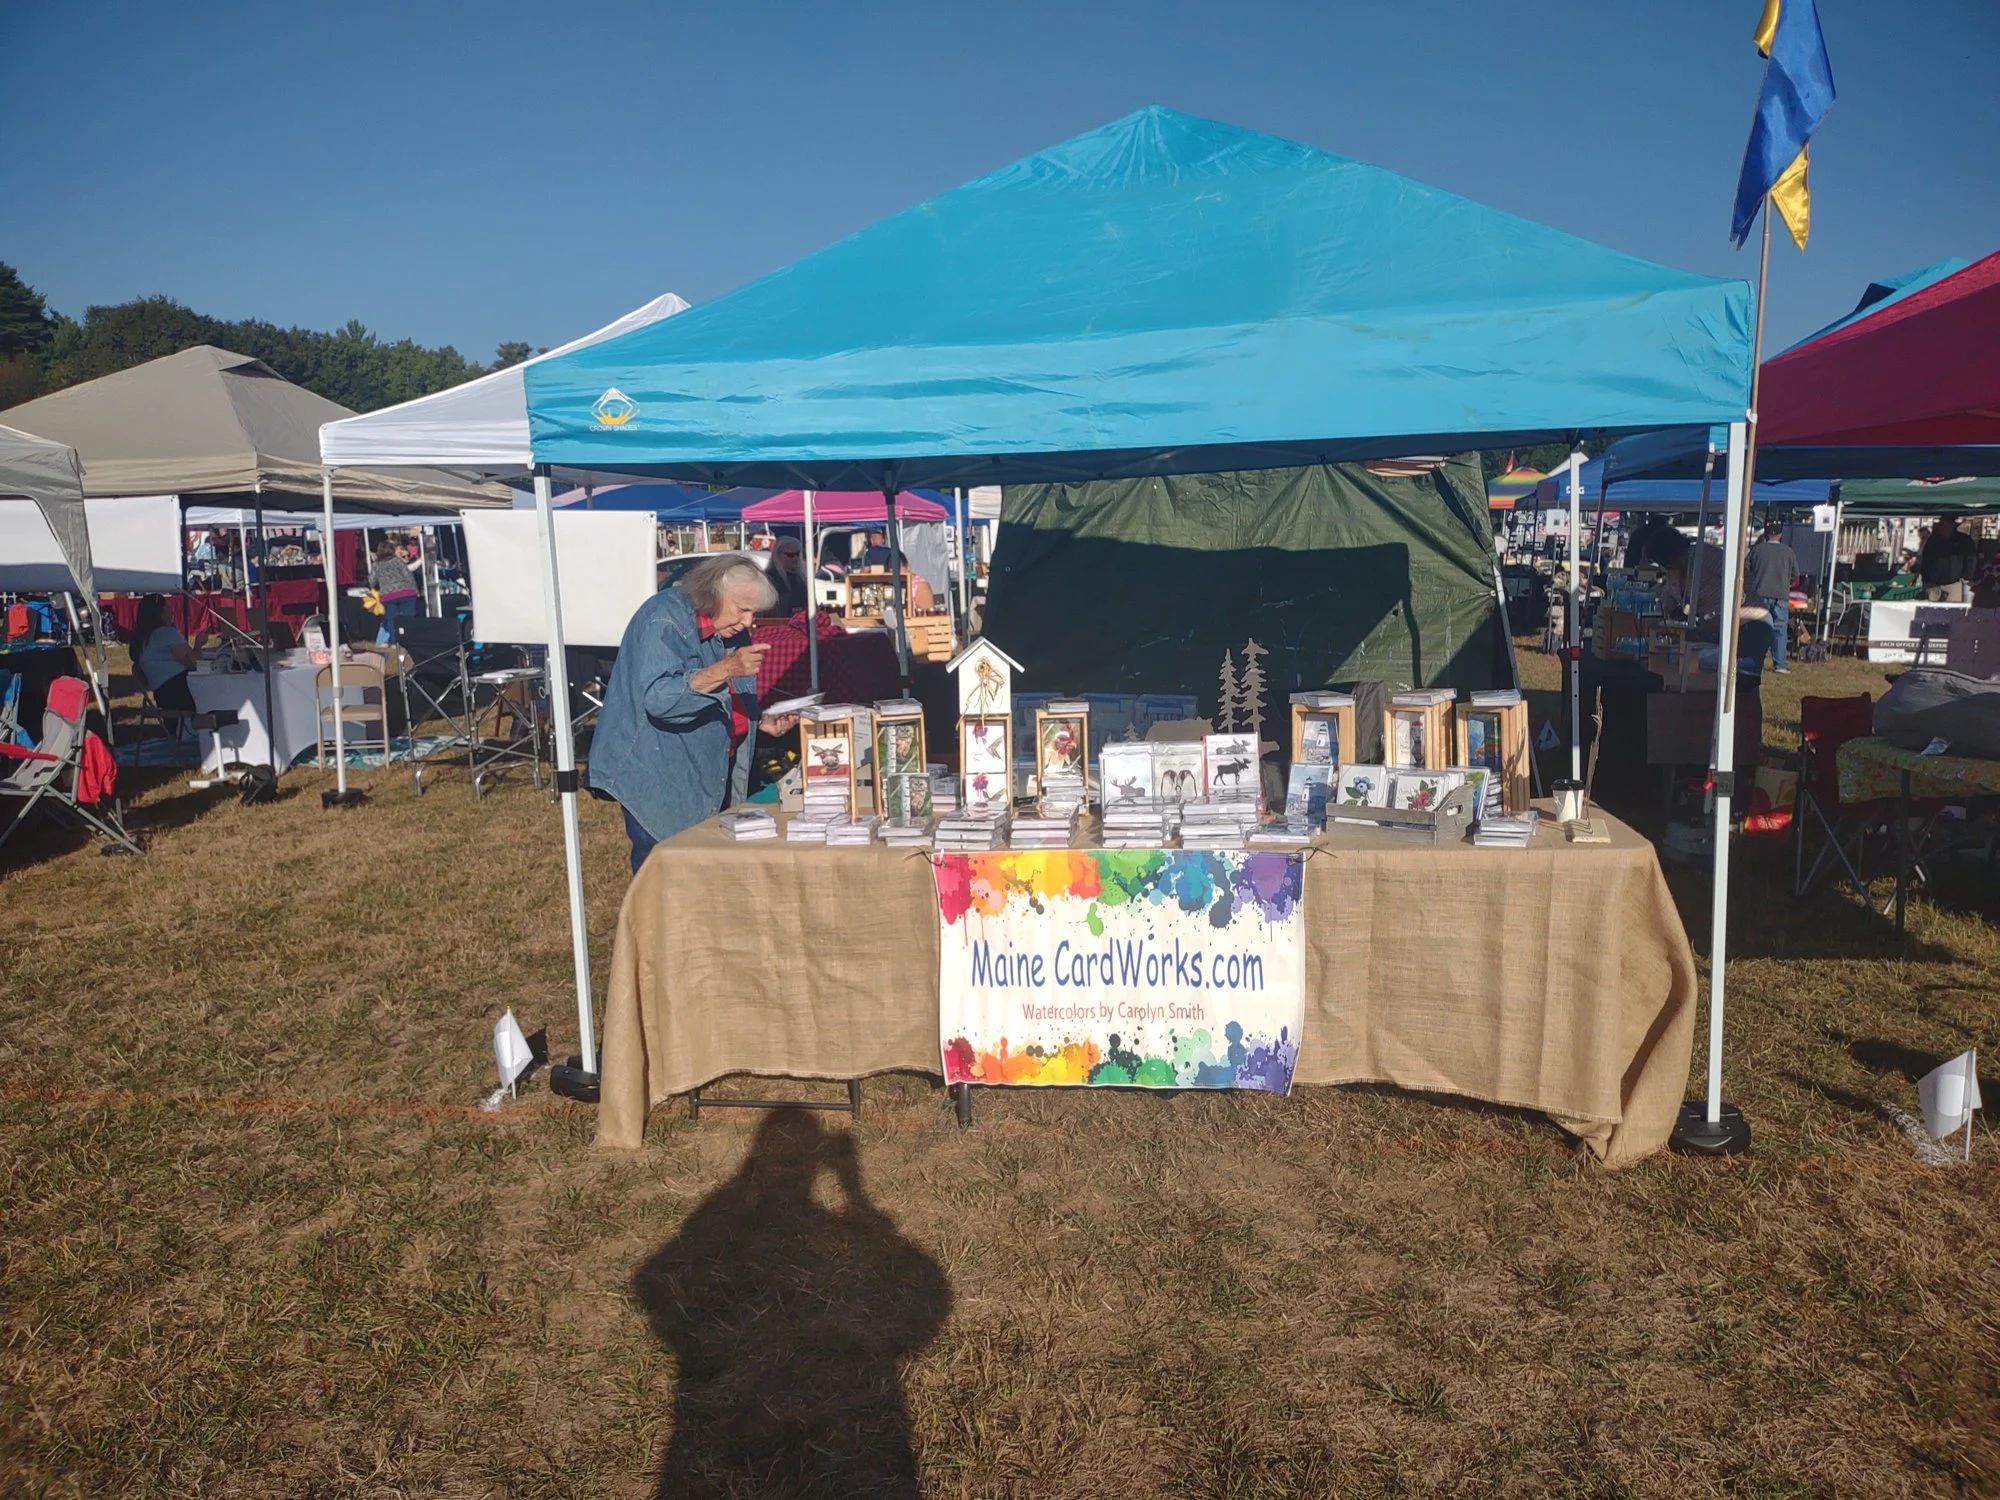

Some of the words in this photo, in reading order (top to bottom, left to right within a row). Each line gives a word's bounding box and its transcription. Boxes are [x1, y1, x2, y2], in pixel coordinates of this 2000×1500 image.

[971, 938, 1046, 988] Maine
[1054, 936, 1264, 991] CardWorks.com
[1022, 1003, 1096, 1020] Watercolors
[1099, 1001, 1114, 1023] by
[1118, 1001, 1165, 1023] Carolyn
[1168, 1002, 1205, 1021] Smith
